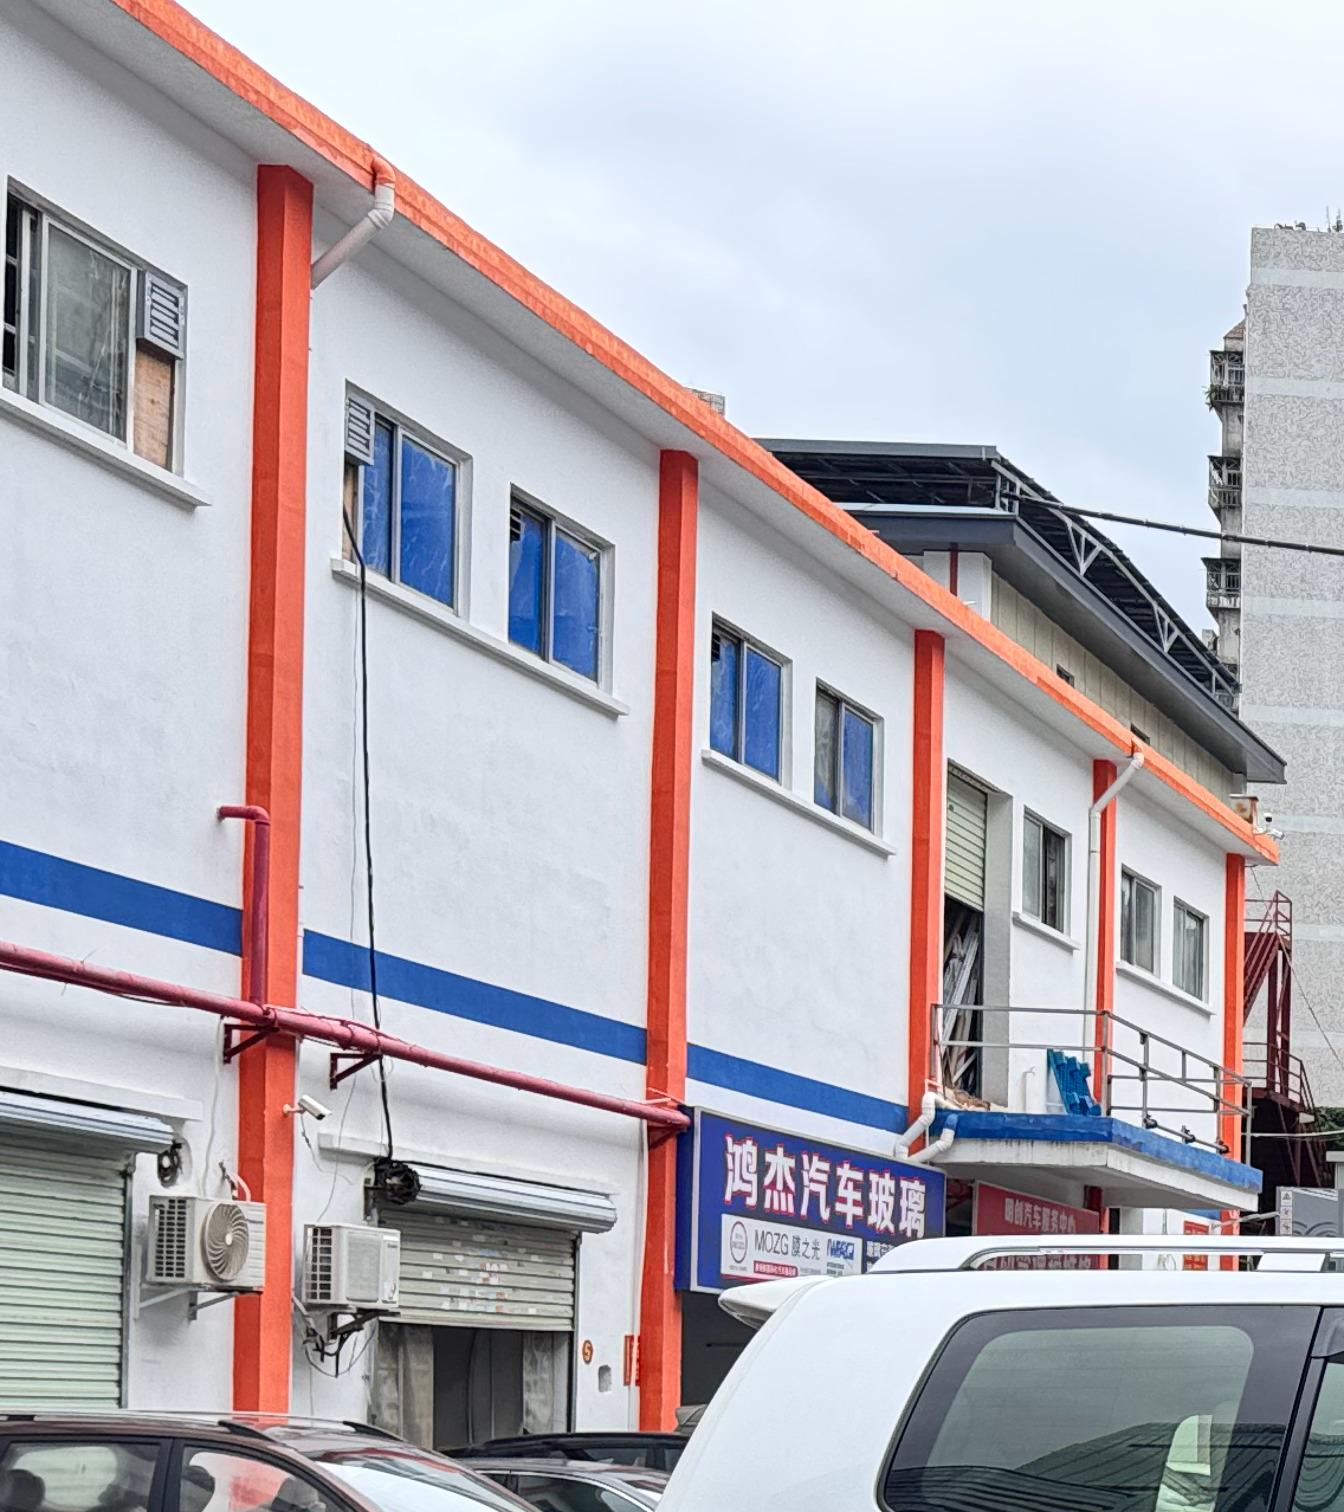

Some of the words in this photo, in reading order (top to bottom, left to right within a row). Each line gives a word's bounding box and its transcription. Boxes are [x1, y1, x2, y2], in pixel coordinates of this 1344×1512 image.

[724, 1133, 926, 1239] 鸿杰汽车玻璃
[755, 1230, 789, 1256] MOZG
